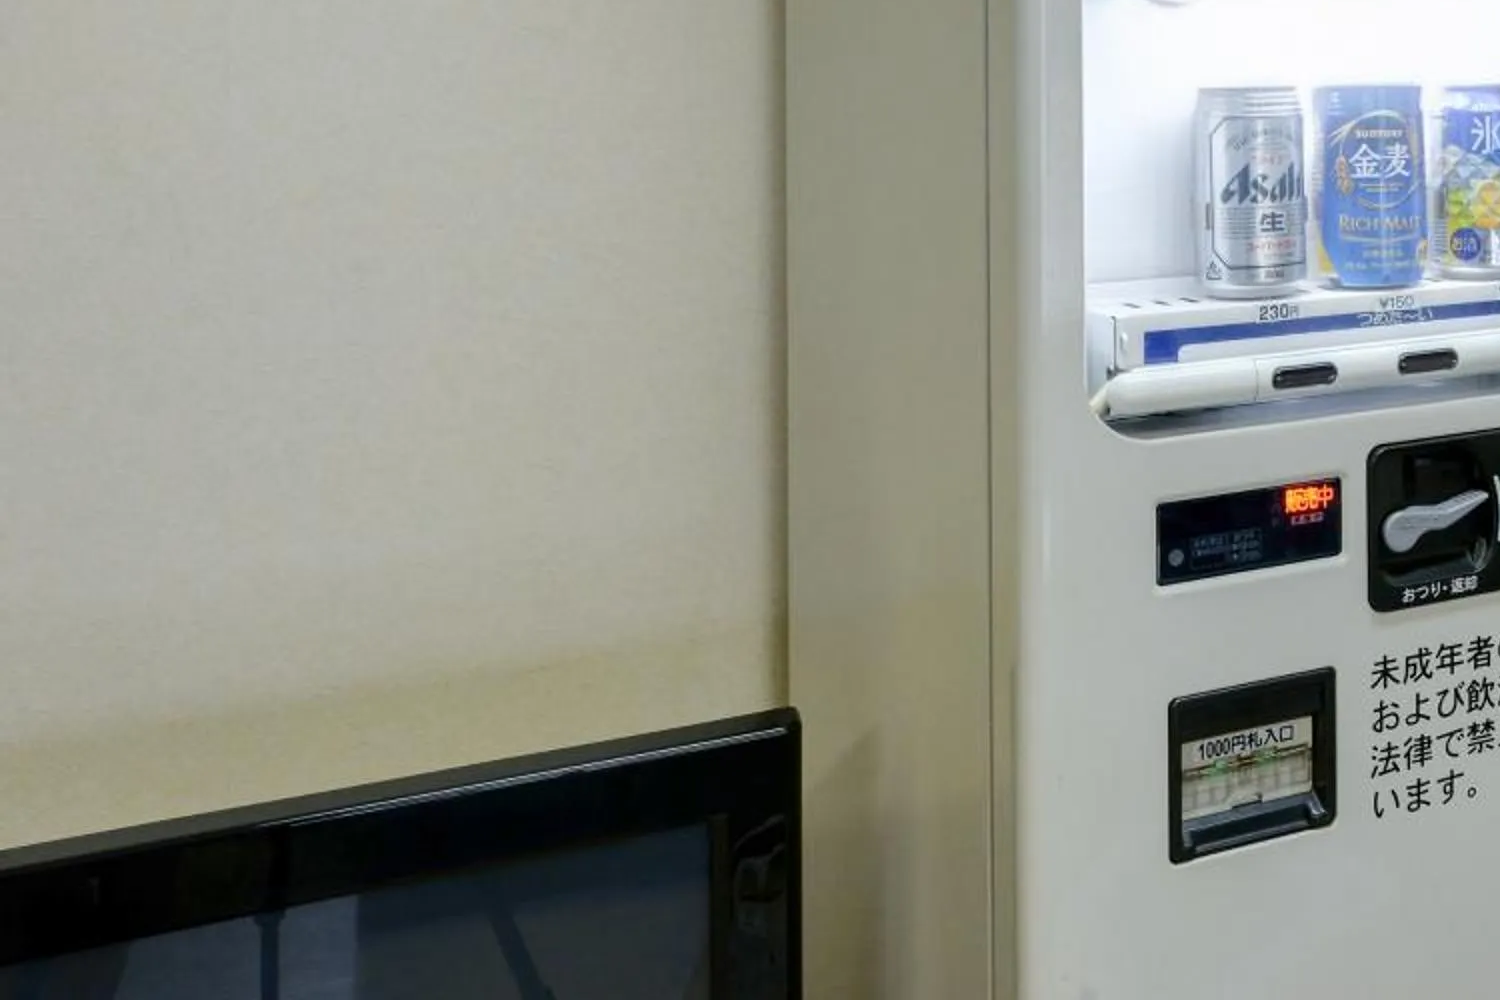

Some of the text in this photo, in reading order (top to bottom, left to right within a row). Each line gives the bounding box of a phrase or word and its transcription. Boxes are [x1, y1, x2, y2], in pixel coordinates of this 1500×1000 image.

[1349, 143, 1411, 180] 金麦
[1260, 211, 1285, 232] 生
[1339, 214, 1380, 231] RICH
[1198, 724, 1296, 761] 1000円札入口
[1372, 768, 1477, 819] います。
